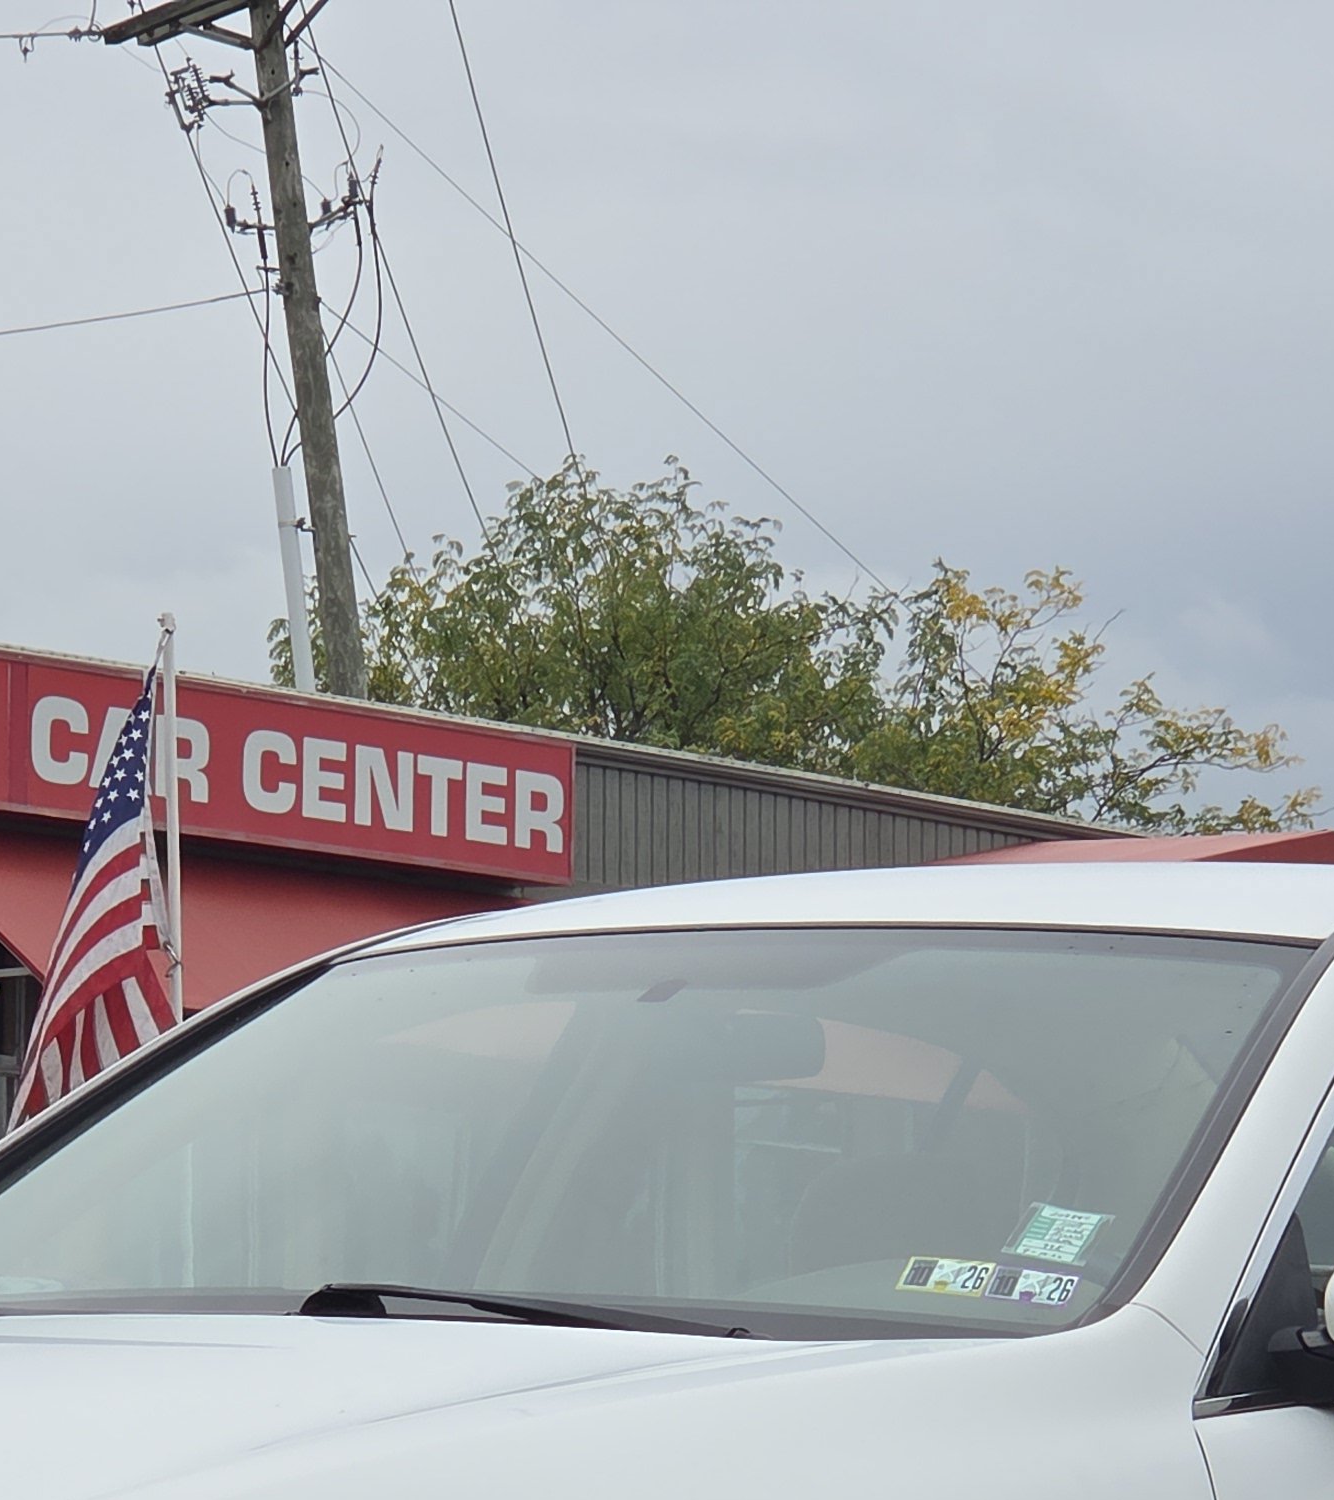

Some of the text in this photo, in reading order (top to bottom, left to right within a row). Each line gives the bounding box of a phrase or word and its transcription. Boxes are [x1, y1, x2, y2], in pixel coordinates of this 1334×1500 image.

[242, 729, 563, 853] CENTER
[960, 1265, 989, 1290] 26
[1046, 1277, 1075, 1302] 26
